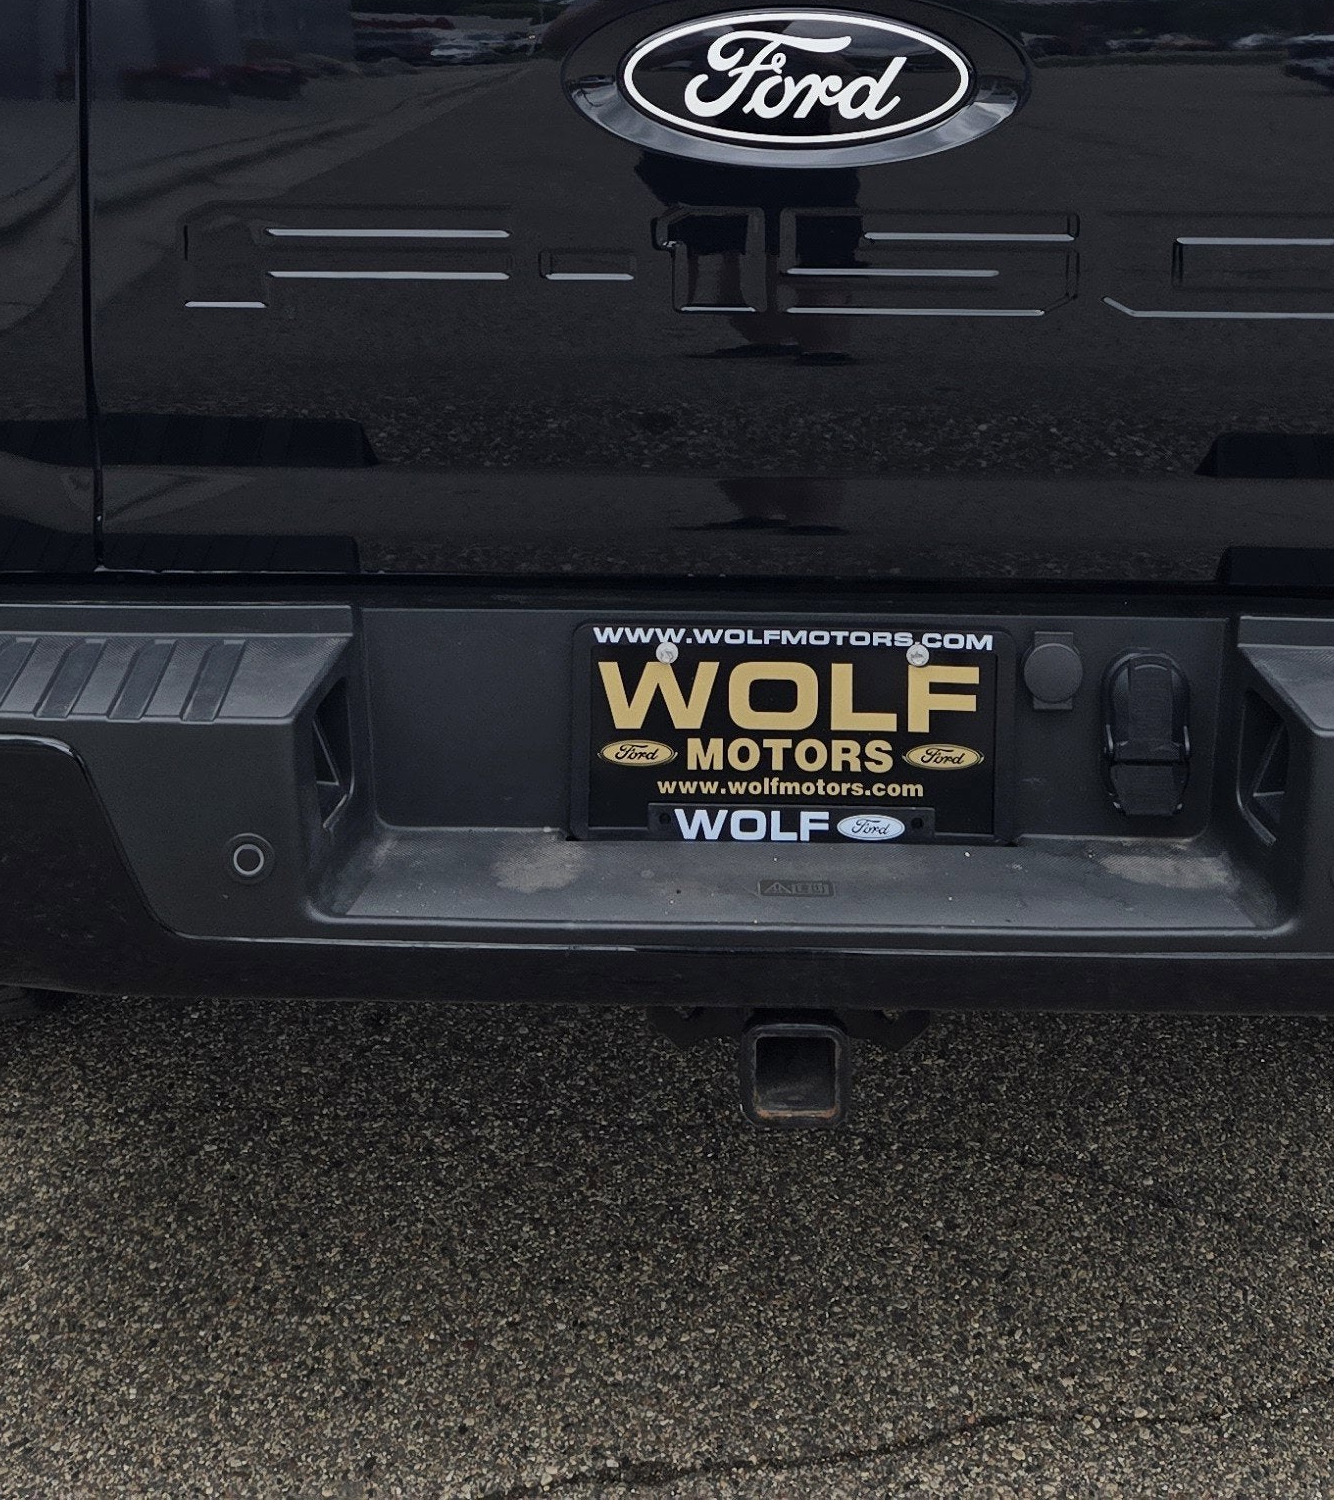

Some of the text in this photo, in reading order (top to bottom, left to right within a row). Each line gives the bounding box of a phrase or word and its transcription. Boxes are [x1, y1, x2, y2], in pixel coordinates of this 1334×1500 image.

[684, 30, 907, 120] Ford
[593, 627, 993, 650] WWW.WOLFMOTORS.COM
[598, 661, 980, 733] WOLF
[615, 744, 659, 760] Ford
[687, 737, 894, 773] MOTORS
[920, 747, 966, 765] Ford
[657, 777, 924, 797] www.wolfmotors.com
[674, 808, 891, 841] WOLF Ford
